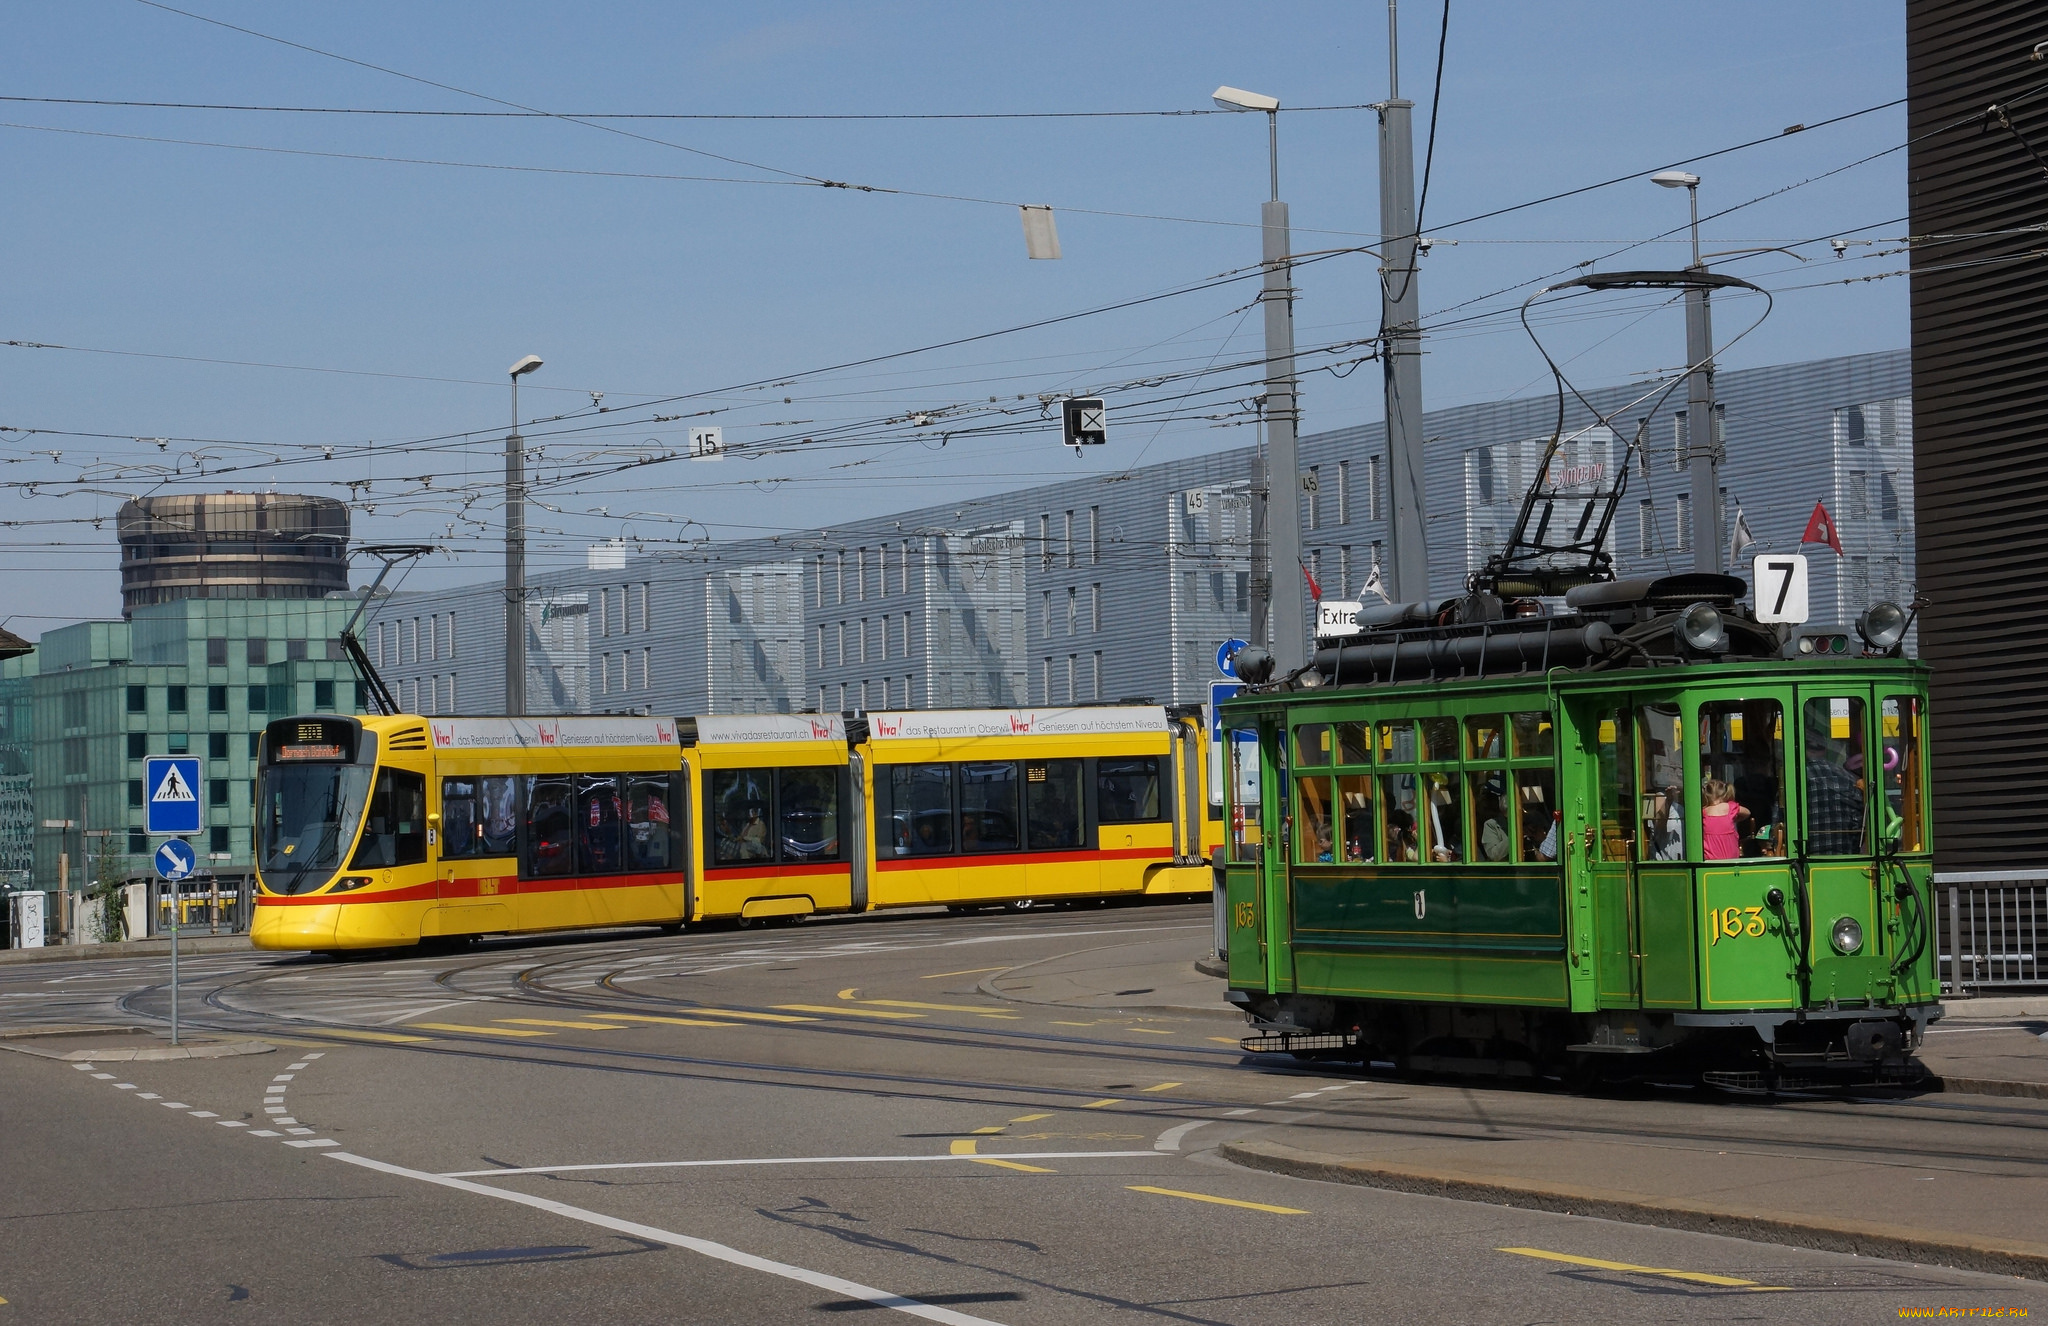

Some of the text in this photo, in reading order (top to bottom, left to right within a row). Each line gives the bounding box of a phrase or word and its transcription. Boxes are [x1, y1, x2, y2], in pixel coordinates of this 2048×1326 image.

[696, 433, 716, 455] 15
[1303, 477, 1318, 492] 45
[1189, 493, 1203, 509] 45
[1768, 562, 1795, 615] 7
[1323, 608, 1356, 625] Extra
[877, 716, 1009, 737] Viva! das Restaurant in Oberwil
[1038, 722, 1080, 732] Geniessen
[1081, 721, 1094, 731] auf
[1095, 720, 1134, 731] höchstem
[1135, 719, 1163, 730] Niveau
[458, 735, 470, 746] das
[471, 734, 506, 745] Restaurant
[507, 734, 513, 745] in
[561, 733, 593, 745] Geniessen
[594, 733, 605, 744] auf
[605, 732, 635, 744] höchstem
[636, 731, 657, 743] Niveau
[710, 730, 809, 742] www.vivadasrestaurant.ch
[479, 878, 500, 895] BLT
[1235, 901, 1255, 933] 163
[1710, 906, 1767, 946] 163
